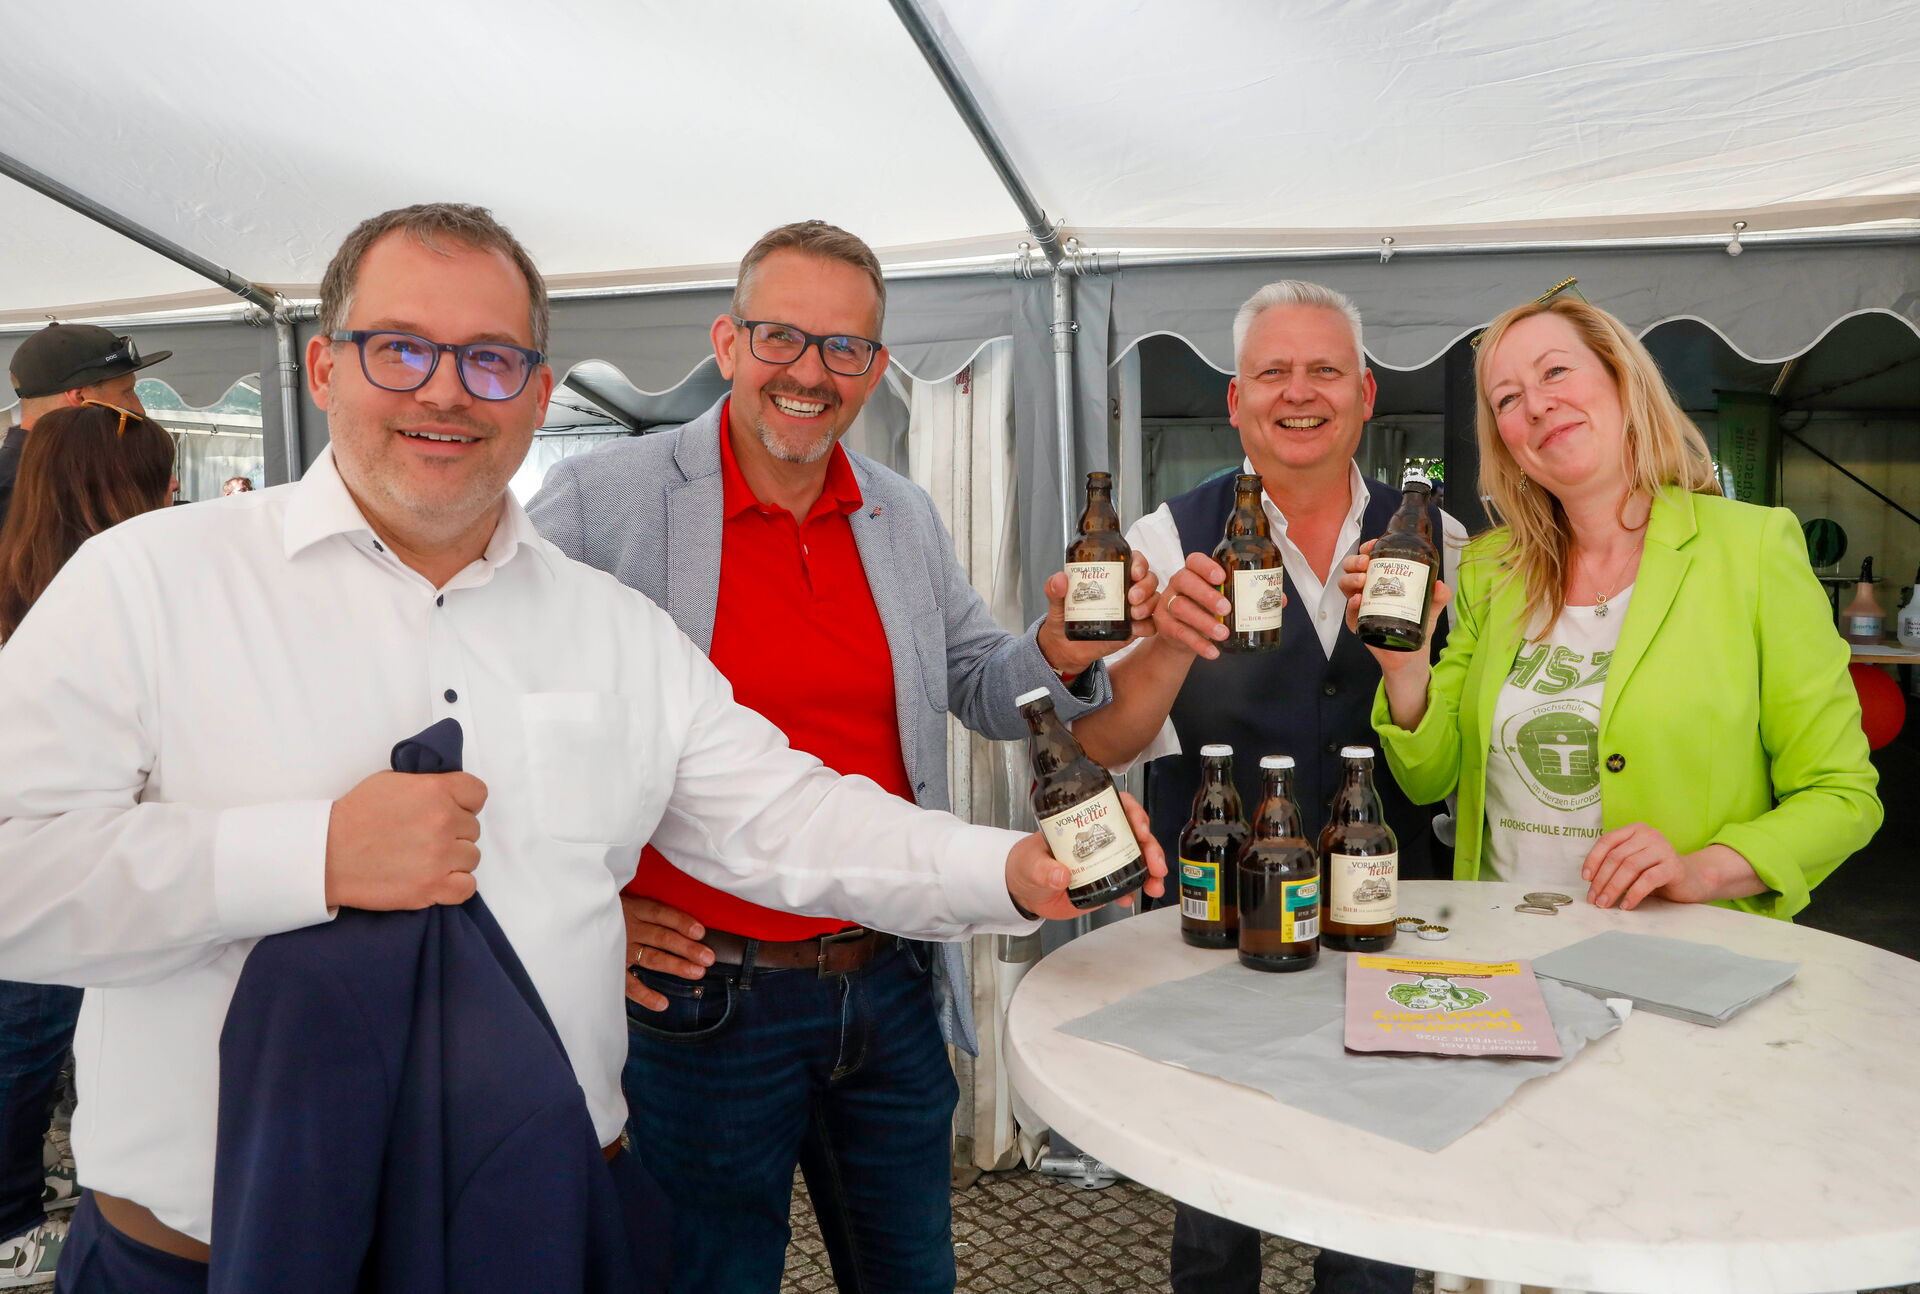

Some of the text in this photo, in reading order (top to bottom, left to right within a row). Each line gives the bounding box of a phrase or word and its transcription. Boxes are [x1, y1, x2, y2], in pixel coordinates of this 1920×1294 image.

[1373, 562, 1410, 570] VORLAUBEN
[1383, 566, 1415, 577] Keller
[1080, 570, 1110, 579] Keller
[1533, 702, 1584, 717] Hochschule
[1543, 790, 1569, 806] Herzen
[1055, 802, 1101, 827] VORLAUBEN
[1075, 805, 1109, 829] Keller
[1500, 818, 1560, 836] HOCHSCHULE
[1352, 860, 1392, 869] VORLAUBEN
[1368, 865, 1395, 877] Keller
